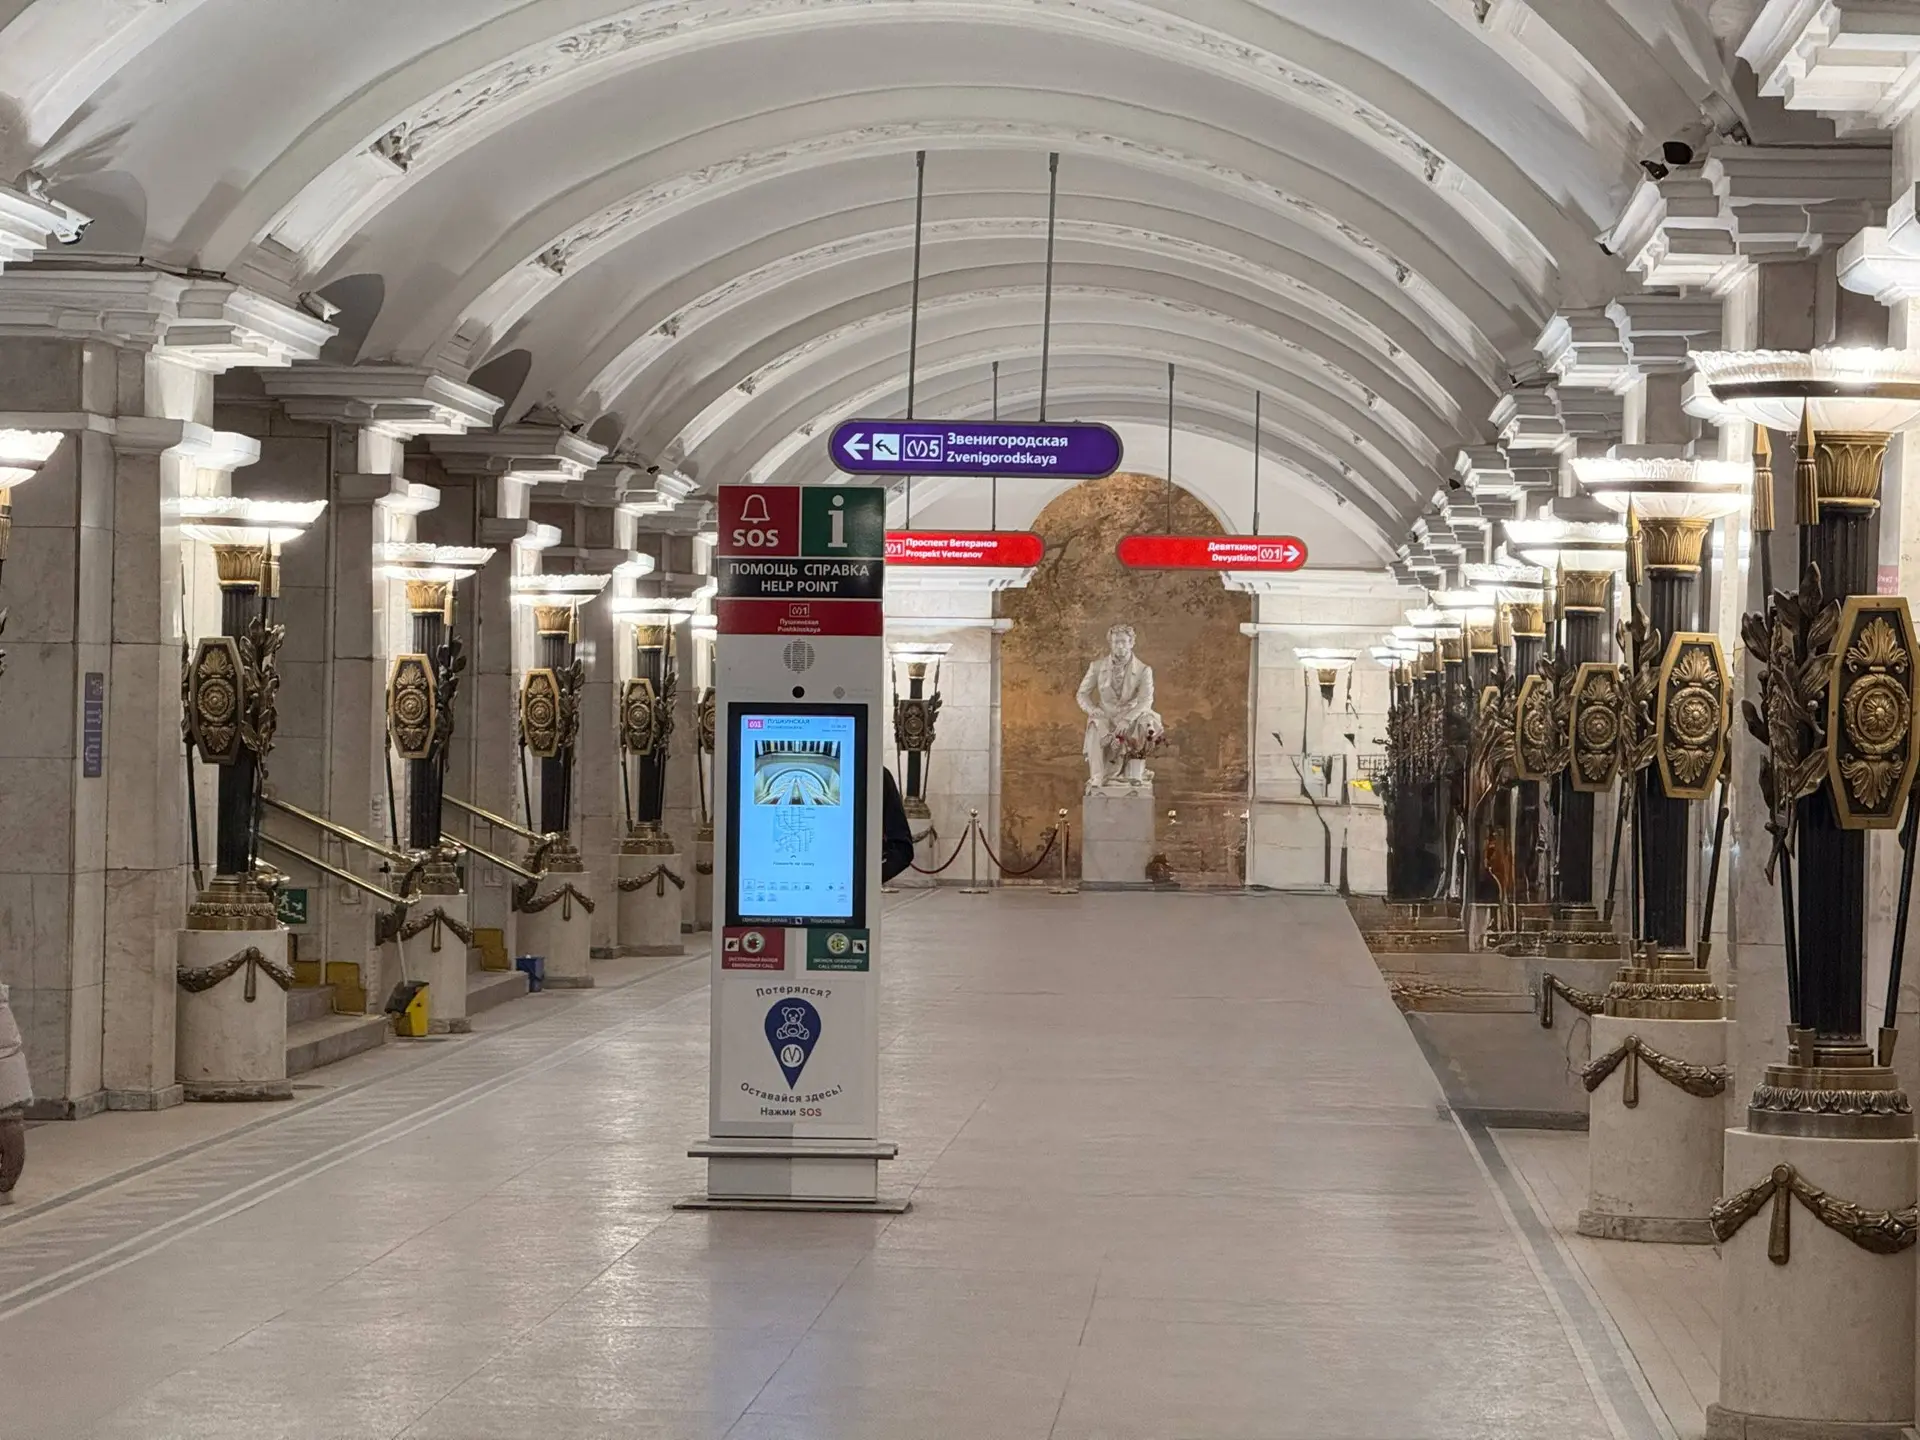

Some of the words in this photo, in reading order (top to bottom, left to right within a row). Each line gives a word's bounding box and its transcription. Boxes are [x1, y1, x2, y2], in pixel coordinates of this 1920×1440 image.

[947, 432, 1069, 449] Звенигородская
[946, 451, 1058, 467] Zvenigorodskaya
[732, 529, 779, 547] SOS
[905, 538, 948, 548] Проспект
[949, 538, 998, 549] Ветеранов
[1207, 542, 1258, 552] Девяткино
[905, 550, 940, 558] Prospekt
[942, 550, 983, 558] Veteranov
[1212, 553, 1258, 563] Devyatkino
[730, 563, 798, 577] ПОМОЩЬ
[804, 564, 870, 577] СПРАВКА
[761, 581, 794, 592] HELP
[797, 581, 839, 593] POINT
[755, 986, 832, 998] Потерялся?
[740, 1082, 802, 1102] Оставайся
[804, 1084, 844, 1102] здесь!
[760, 1107, 796, 1116] Нажми
[799, 1107, 822, 1117] SOS
